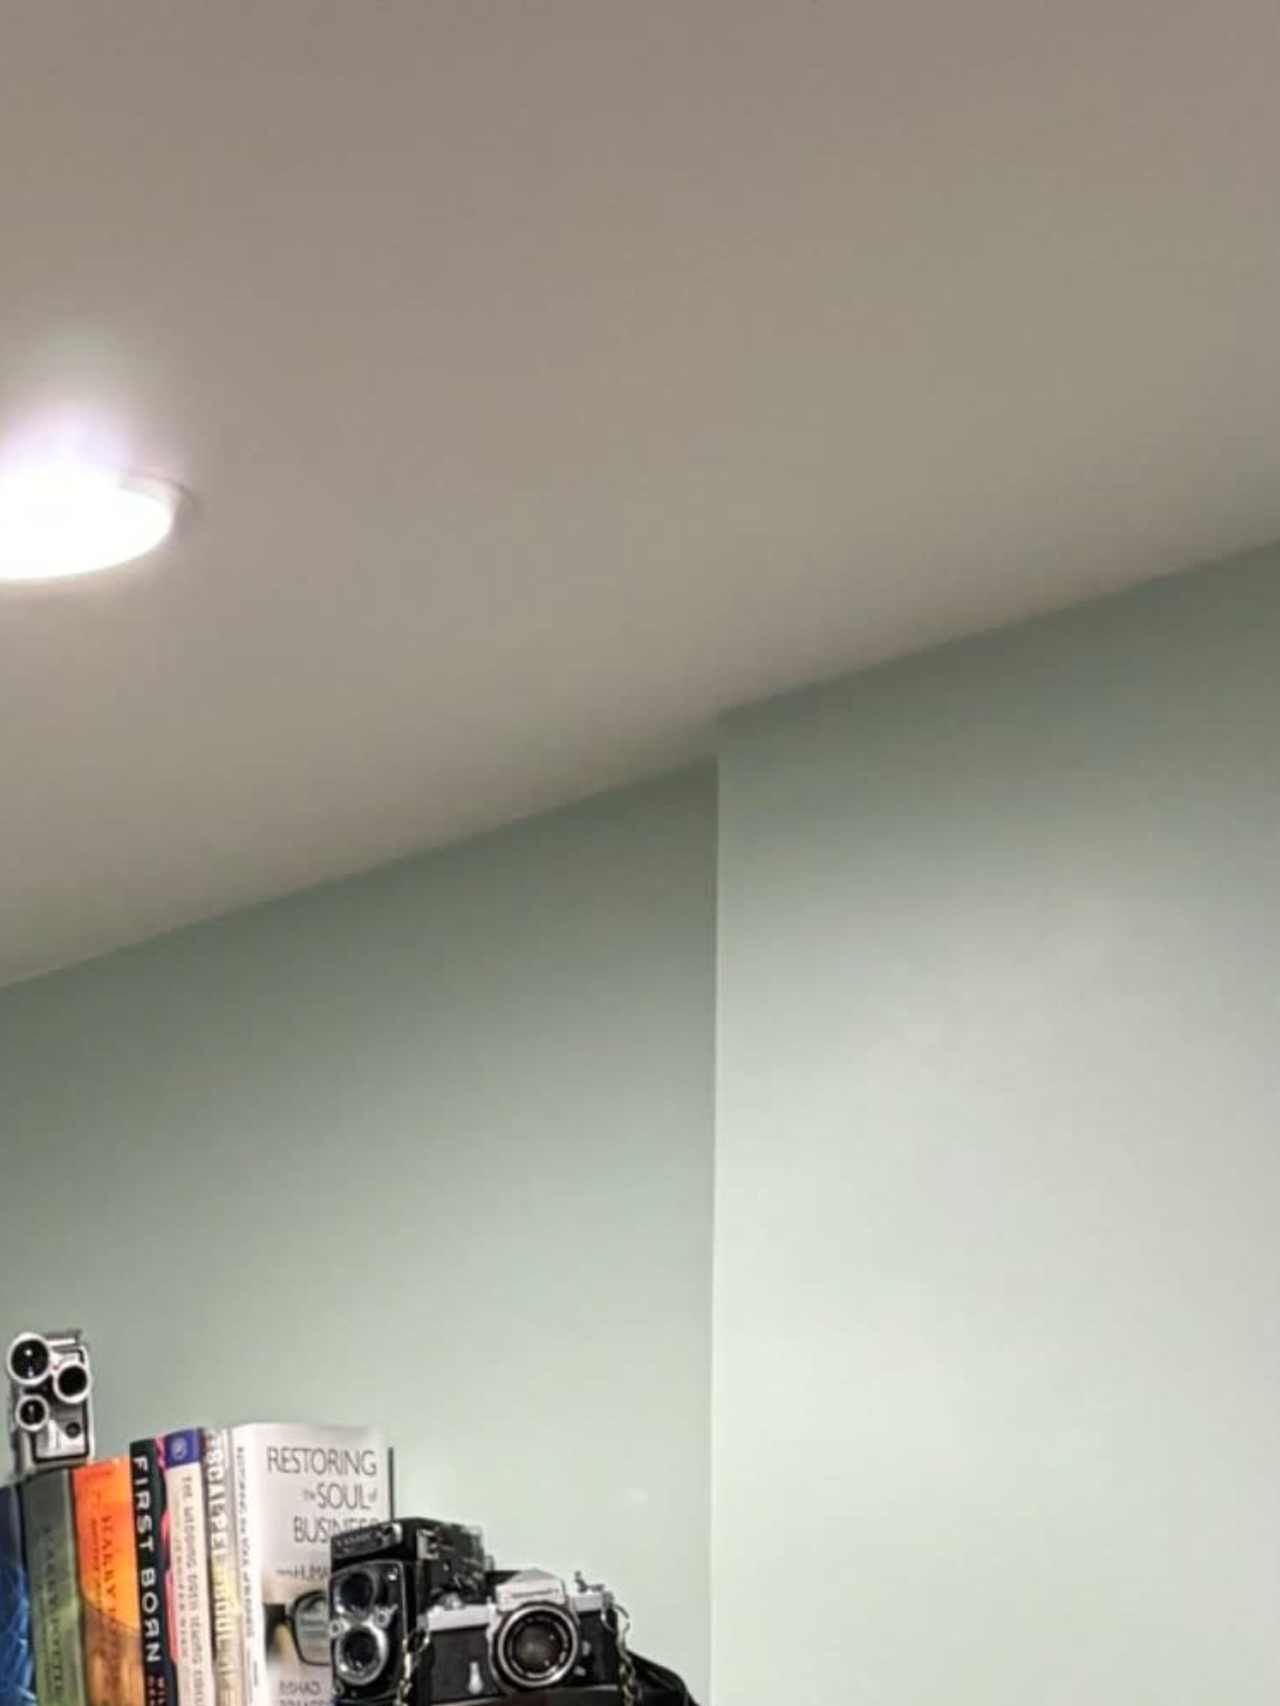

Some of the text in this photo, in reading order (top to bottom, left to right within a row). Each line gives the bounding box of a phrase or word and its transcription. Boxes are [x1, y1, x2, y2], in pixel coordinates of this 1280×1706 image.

[266, 1446, 377, 1476] RESTORING
[132, 1455, 155, 1553] FIRST
[317, 1482, 371, 1510] SOUL
